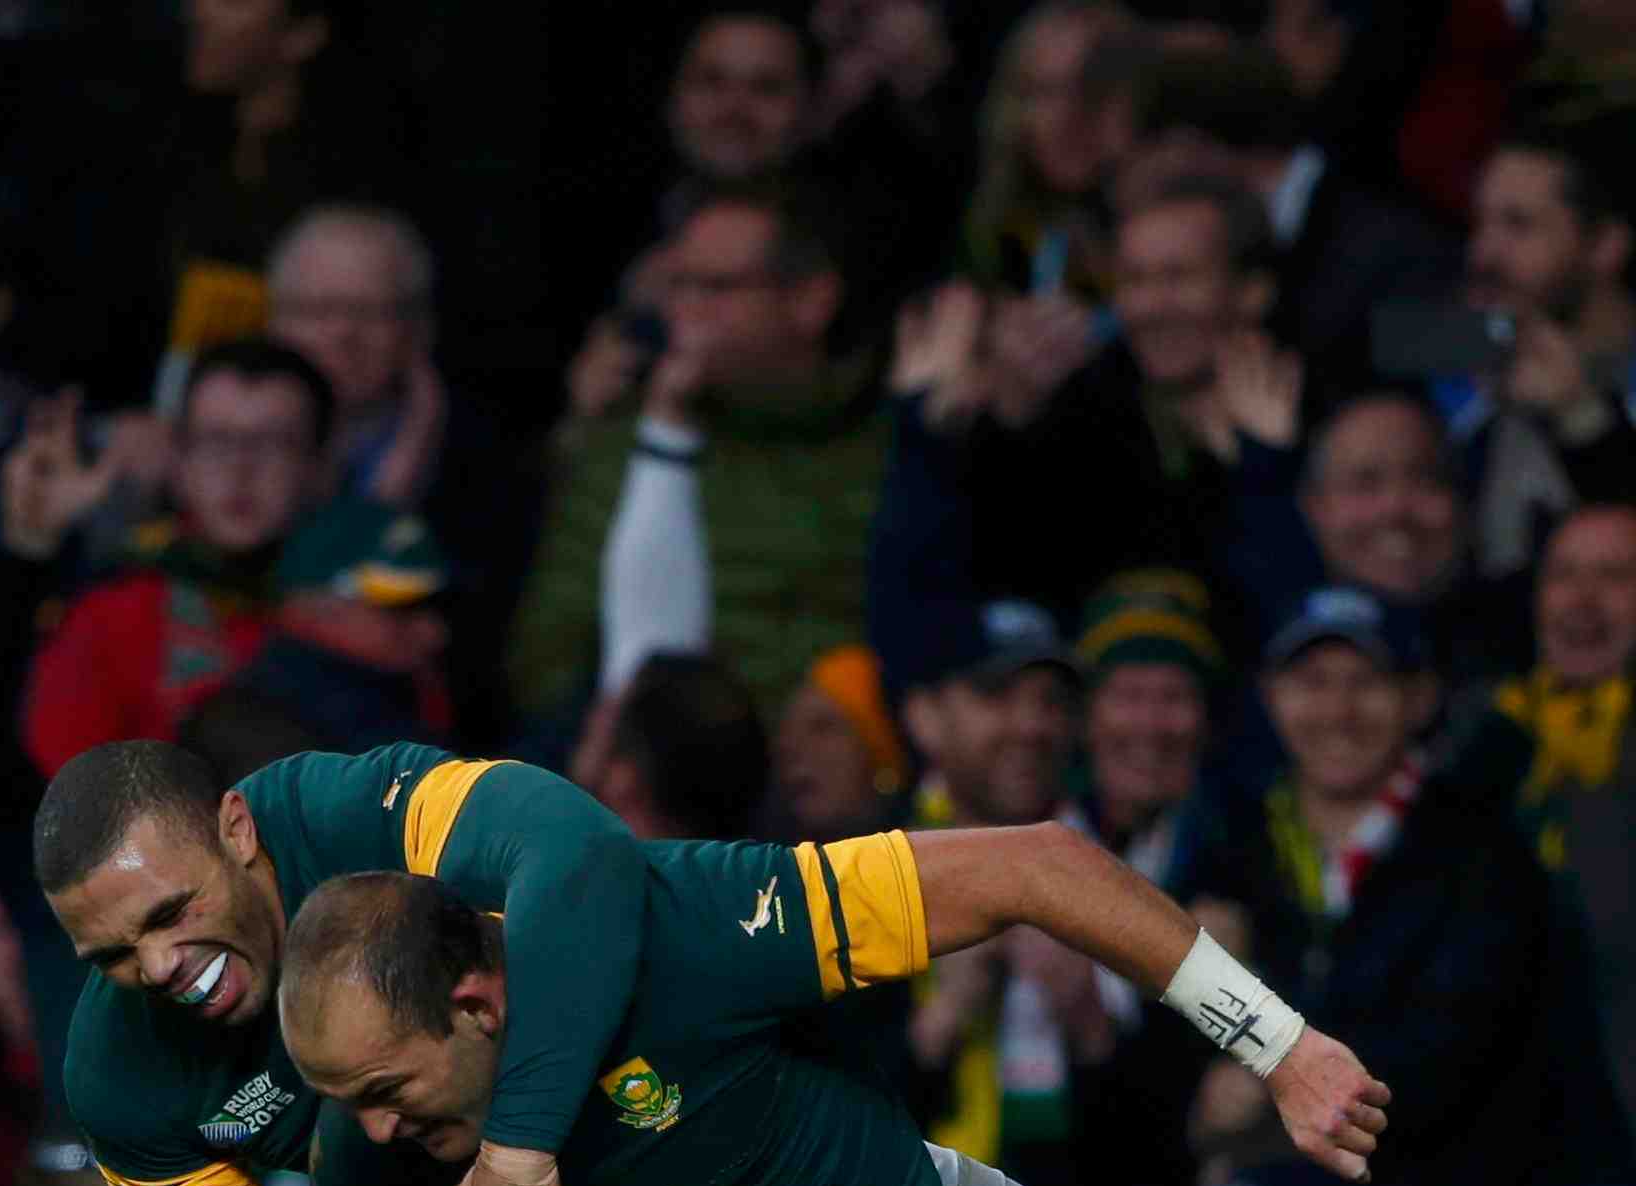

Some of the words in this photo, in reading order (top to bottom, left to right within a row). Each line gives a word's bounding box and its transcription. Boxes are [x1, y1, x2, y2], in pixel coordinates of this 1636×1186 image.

[223, 1071, 273, 1114] RUGBY
[235, 1097, 266, 1118] WORLD
[263, 1087, 281, 1102] CUP
[244, 1092, 295, 1134] 2015
